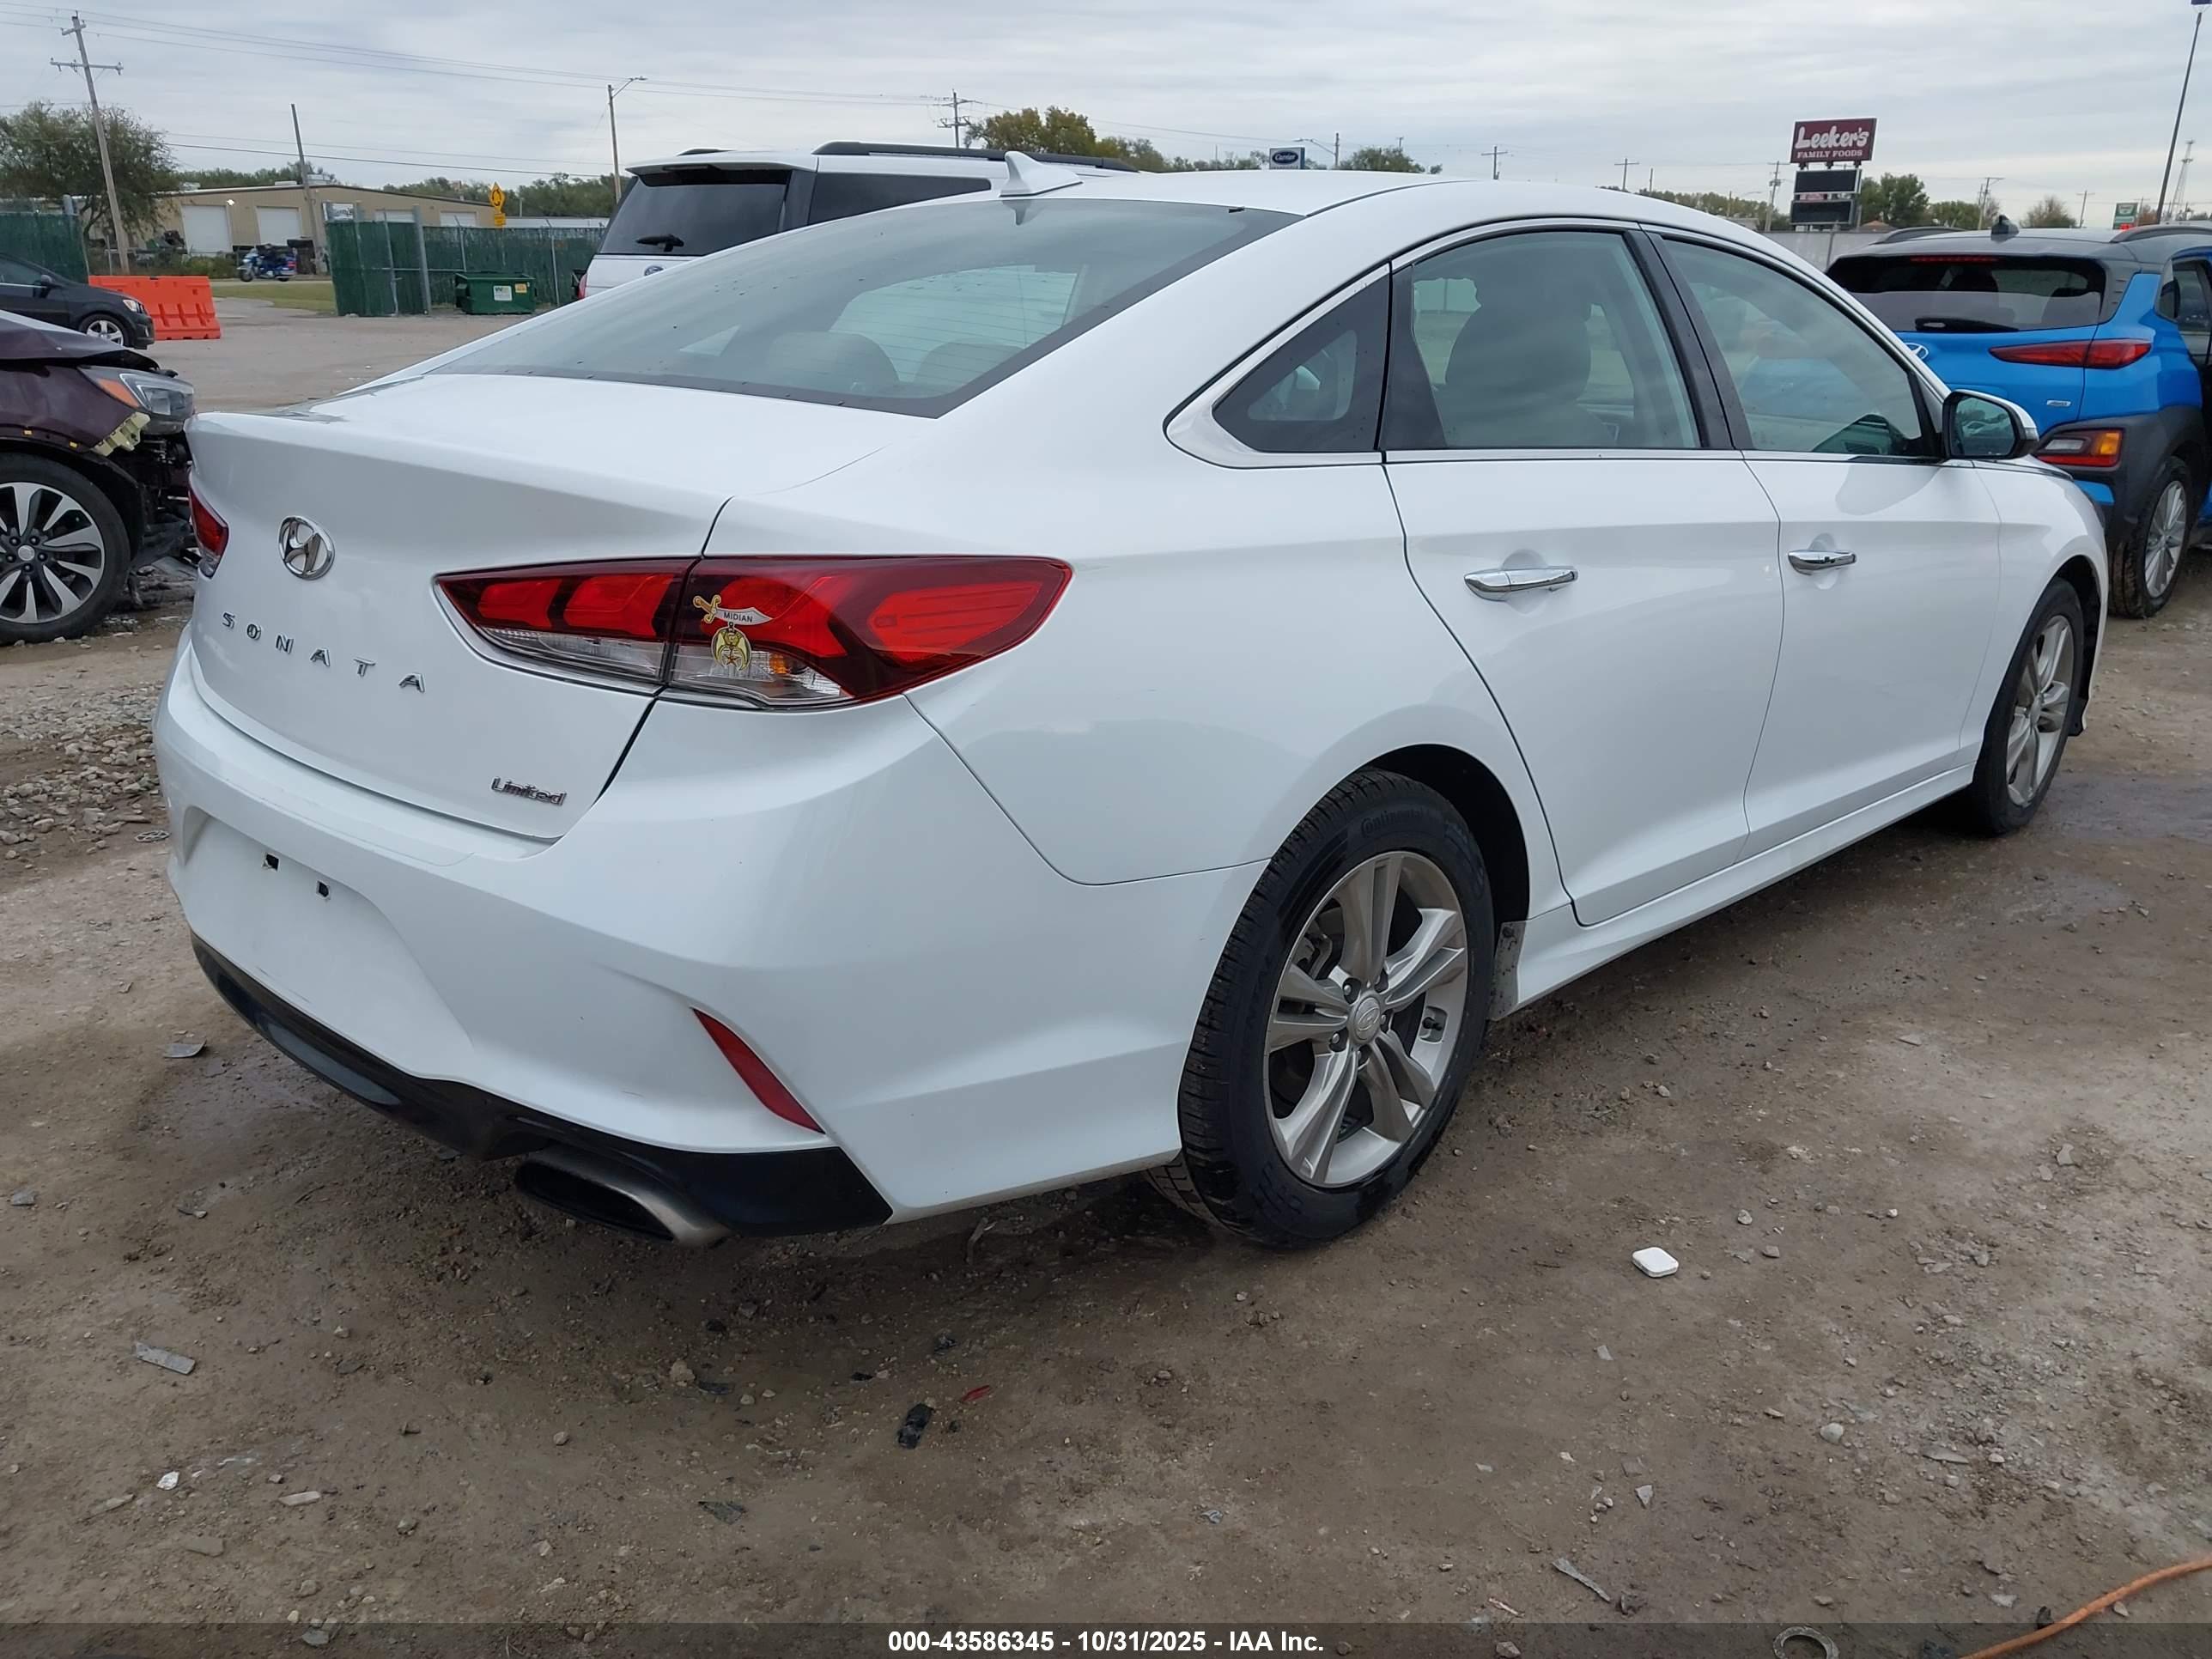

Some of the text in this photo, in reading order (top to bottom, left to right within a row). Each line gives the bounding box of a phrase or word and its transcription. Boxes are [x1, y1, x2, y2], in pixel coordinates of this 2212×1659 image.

[1795, 125, 1870, 149] Leeker's
[723, 611, 753, 623] MIDIAN
[222, 611, 425, 693] SONATA
[490, 776, 568, 806] Limited
